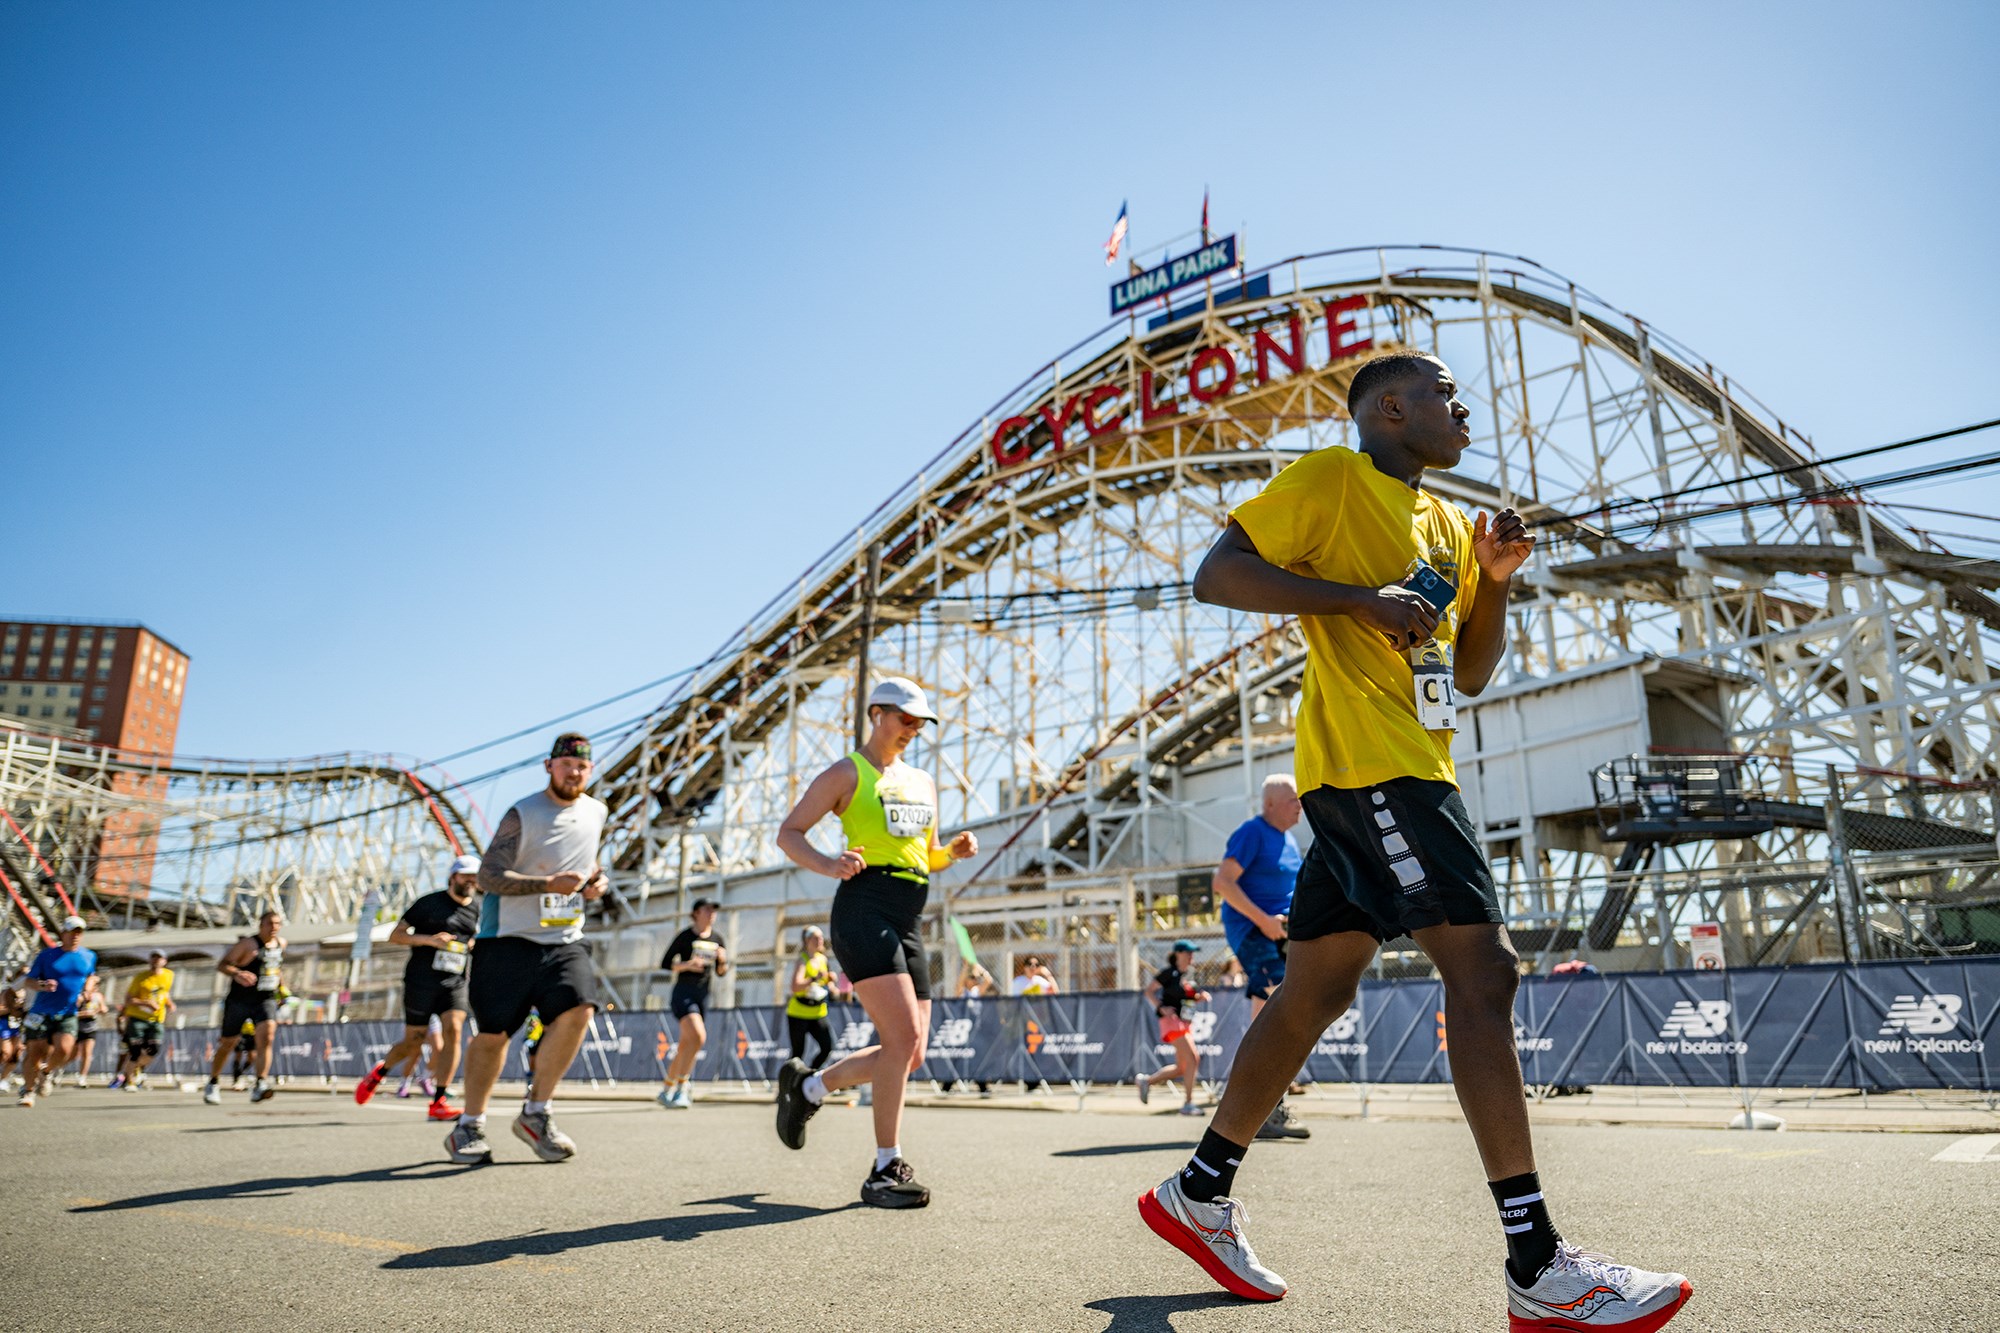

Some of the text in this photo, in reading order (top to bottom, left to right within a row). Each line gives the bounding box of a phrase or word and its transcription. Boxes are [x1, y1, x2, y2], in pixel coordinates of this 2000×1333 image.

[1115, 242, 1229, 308] LUNA PARK
[991, 294, 1373, 465] CYCLONE
[1646, 1039, 1748, 1054] new balance
[1864, 1037, 1984, 1053] new balance
[1507, 1207, 1528, 1218] cep
